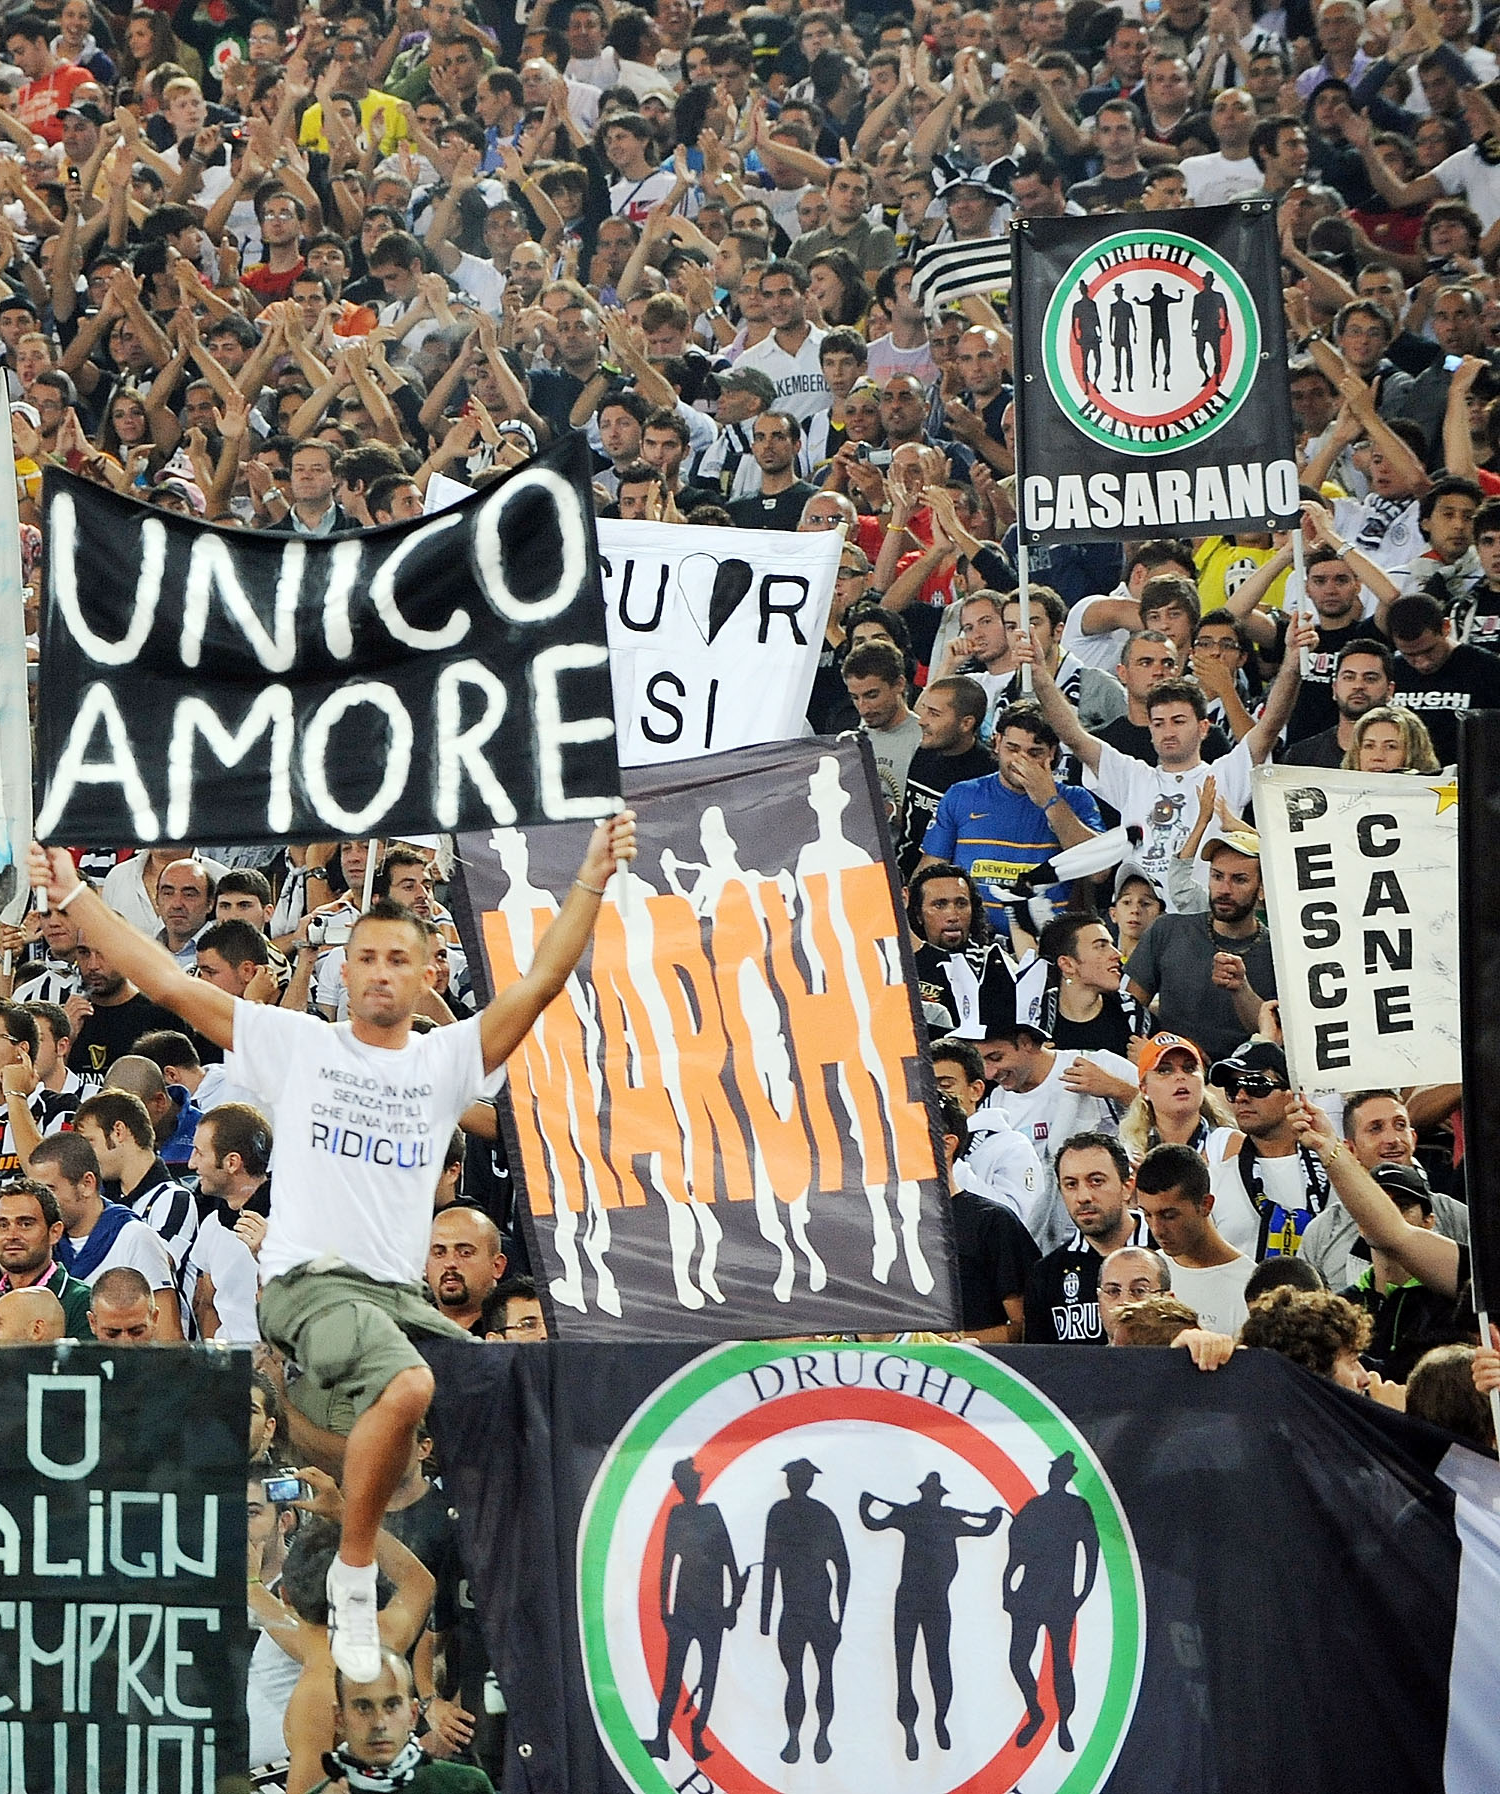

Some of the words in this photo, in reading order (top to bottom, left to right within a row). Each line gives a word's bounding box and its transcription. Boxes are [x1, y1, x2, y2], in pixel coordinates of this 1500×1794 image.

[1095, 242, 1197, 273] DRUGHI
[776, 374, 831, 398] KEMBER
[1078, 389, 1232, 443] BIANCONERI
[1024, 460, 1301, 531] CASARANO
[50, 467, 588, 673] UNICO
[37, 642, 626, 842] AMORE
[641, 671, 718, 749] SI
[1283, 787, 1352, 1071] PESCE
[1357, 813, 1414, 1035] CANE
[482, 860, 938, 1215] MARCHE
[318, 1067, 378, 1091] MEGLIO
[332, 1088, 382, 1112] SENZA
[311, 1102, 344, 1121] CHE
[349, 1111, 382, 1129] UNA
[1052, 1302, 1102, 1341] DRU
[747, 1350, 988, 1418] DRUGHI
